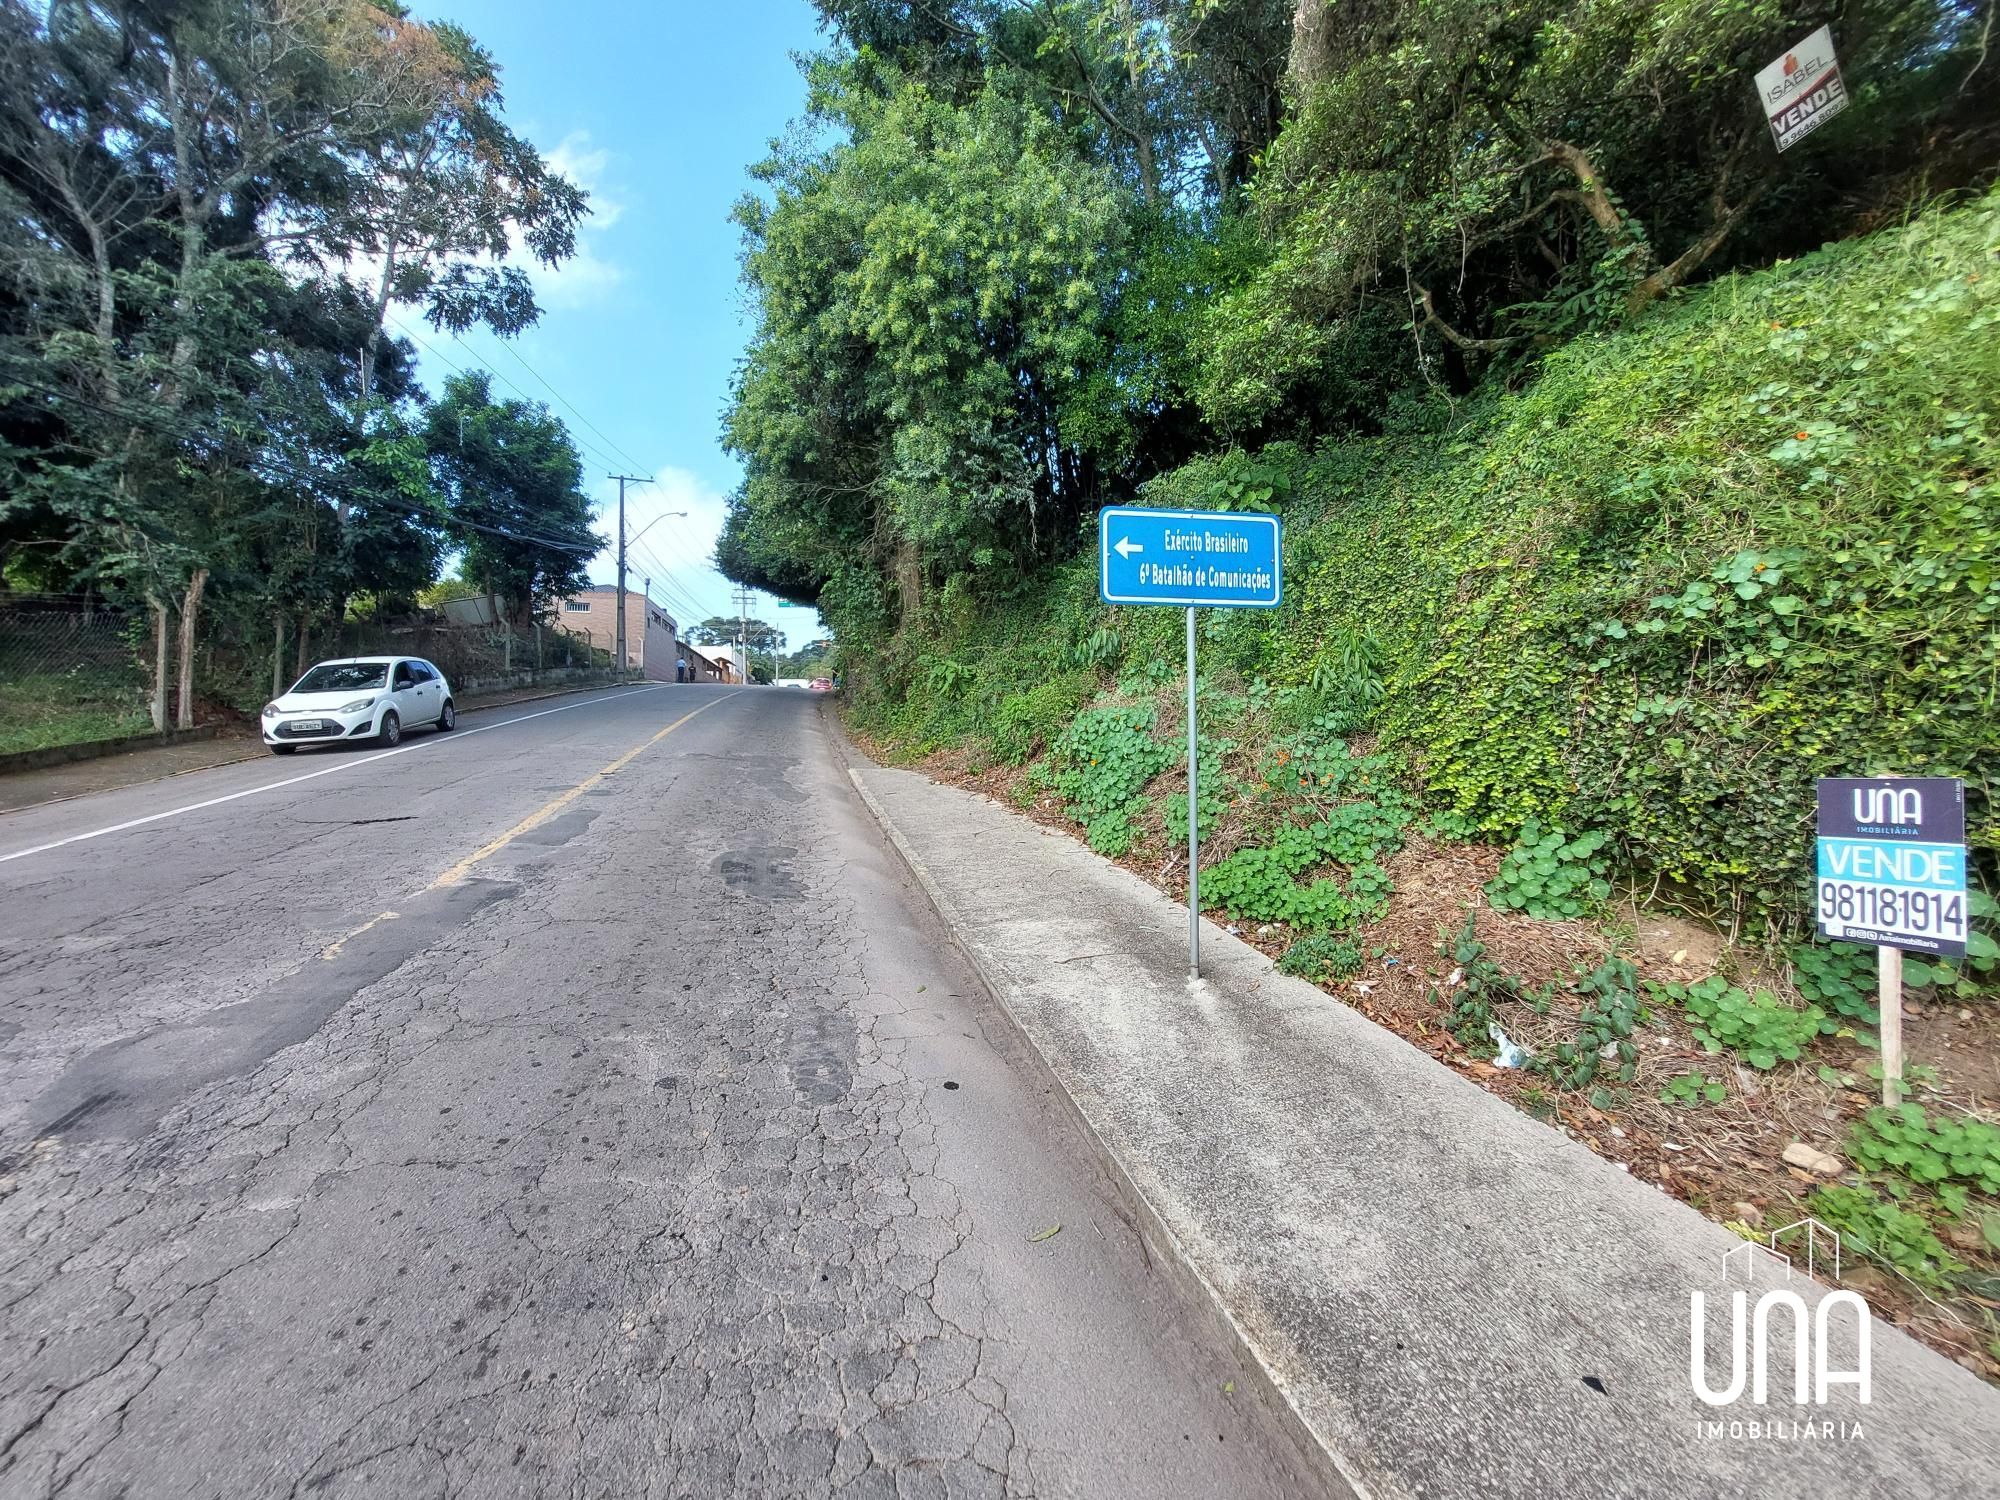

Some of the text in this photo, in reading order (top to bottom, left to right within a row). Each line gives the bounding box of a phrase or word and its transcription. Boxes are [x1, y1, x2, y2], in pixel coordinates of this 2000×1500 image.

[1767, 56, 1828, 104] ISABEL
[1772, 78, 1842, 134] VENDE
[1164, 529, 1249, 553] Exército Brasileiro
[1152, 563, 1193, 587] Batalhão
[1195, 566, 1207, 587] de
[1208, 566, 1271, 593] Comunicações
[1854, 788, 1922, 825] UNA
[1825, 843, 1956, 886] VENDE
